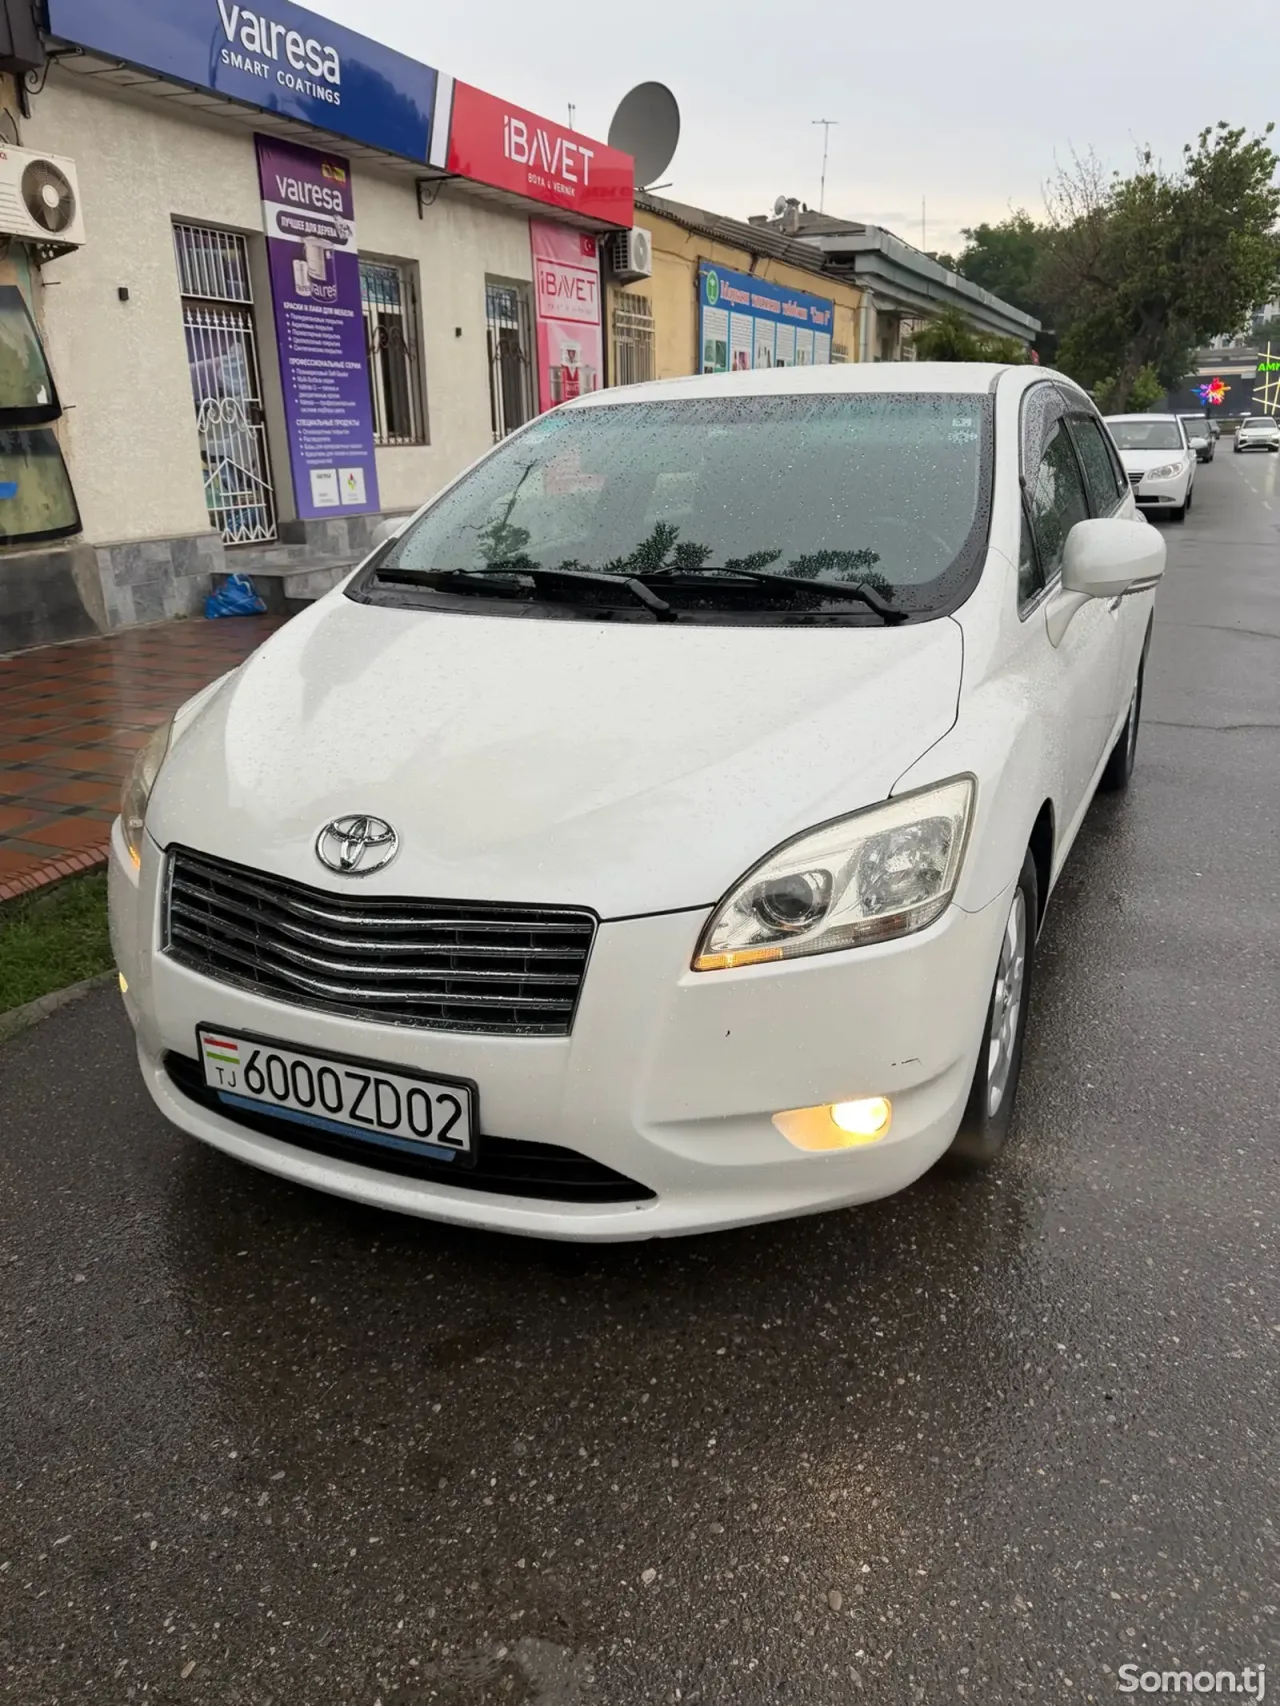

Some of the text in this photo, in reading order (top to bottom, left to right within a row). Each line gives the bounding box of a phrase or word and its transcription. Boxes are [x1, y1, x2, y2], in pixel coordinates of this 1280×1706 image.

[220, 48, 341, 106] SMART COATINGS
[215, 1066, 236, 1088] TJ
[243, 1050, 464, 1147] 6000ZD02
